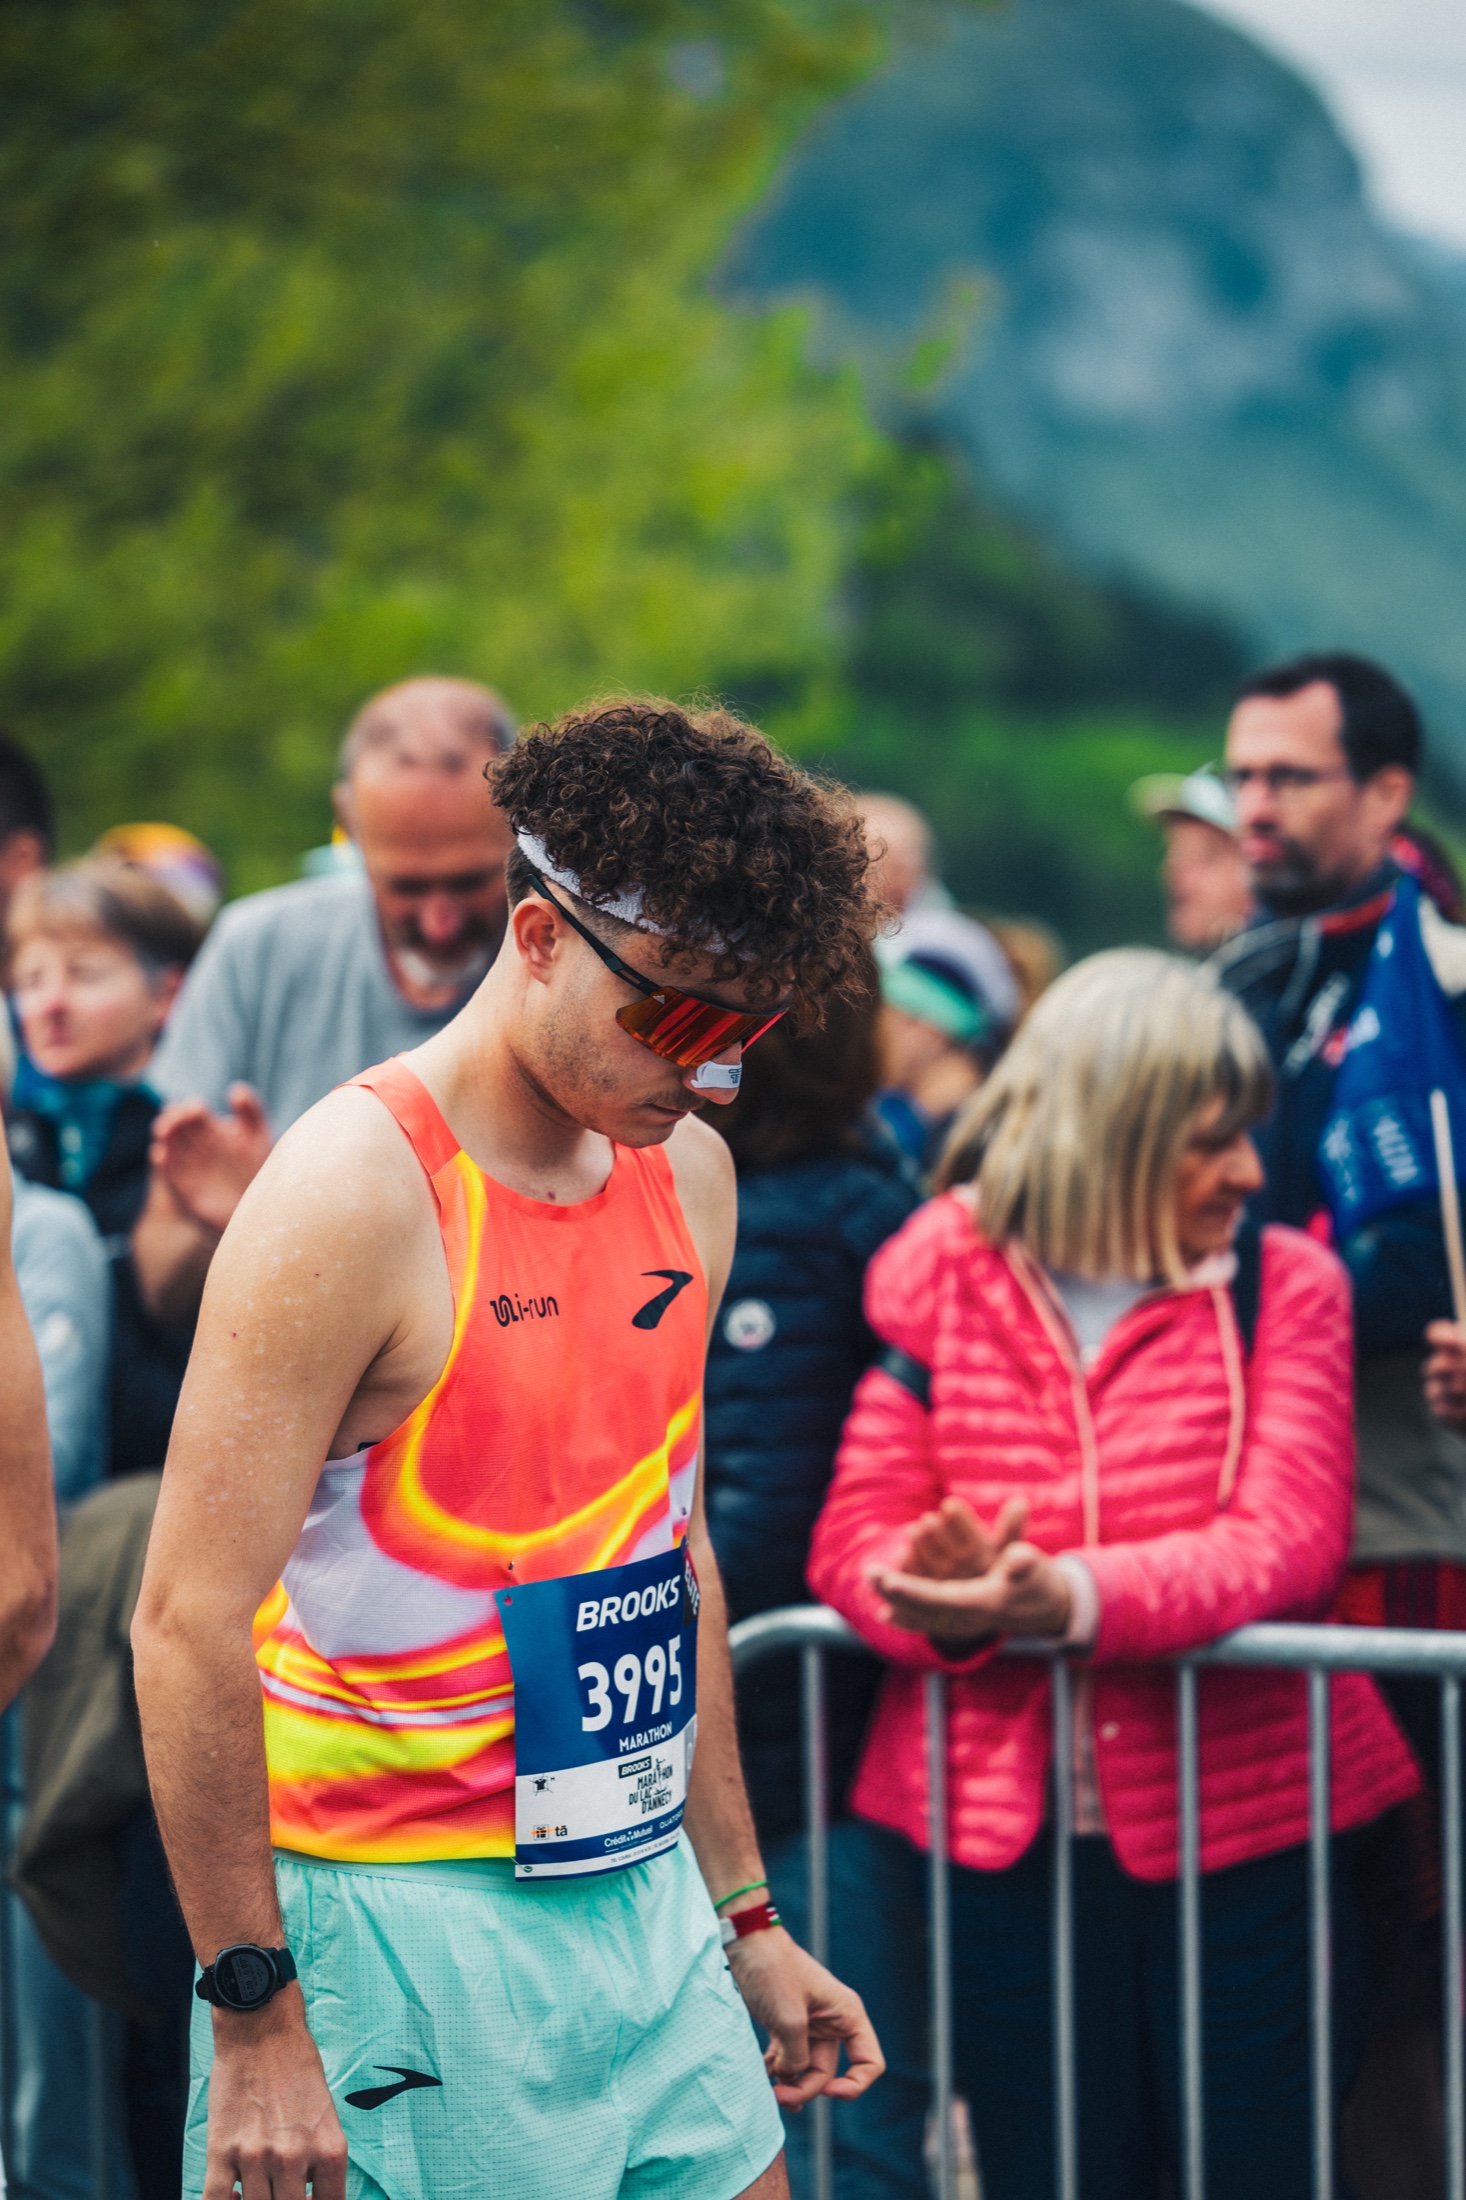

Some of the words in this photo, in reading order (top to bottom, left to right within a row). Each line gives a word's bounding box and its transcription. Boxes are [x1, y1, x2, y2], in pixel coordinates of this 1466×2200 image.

[576, 1574, 681, 1632] BROOKS
[577, 1634, 682, 1732] 3995
[618, 1721, 673, 1753] MARATHON
[620, 1758, 651, 1776] BROOKS
[628, 1792, 639, 1805] DU
[603, 1833, 627, 1847] Crédit
